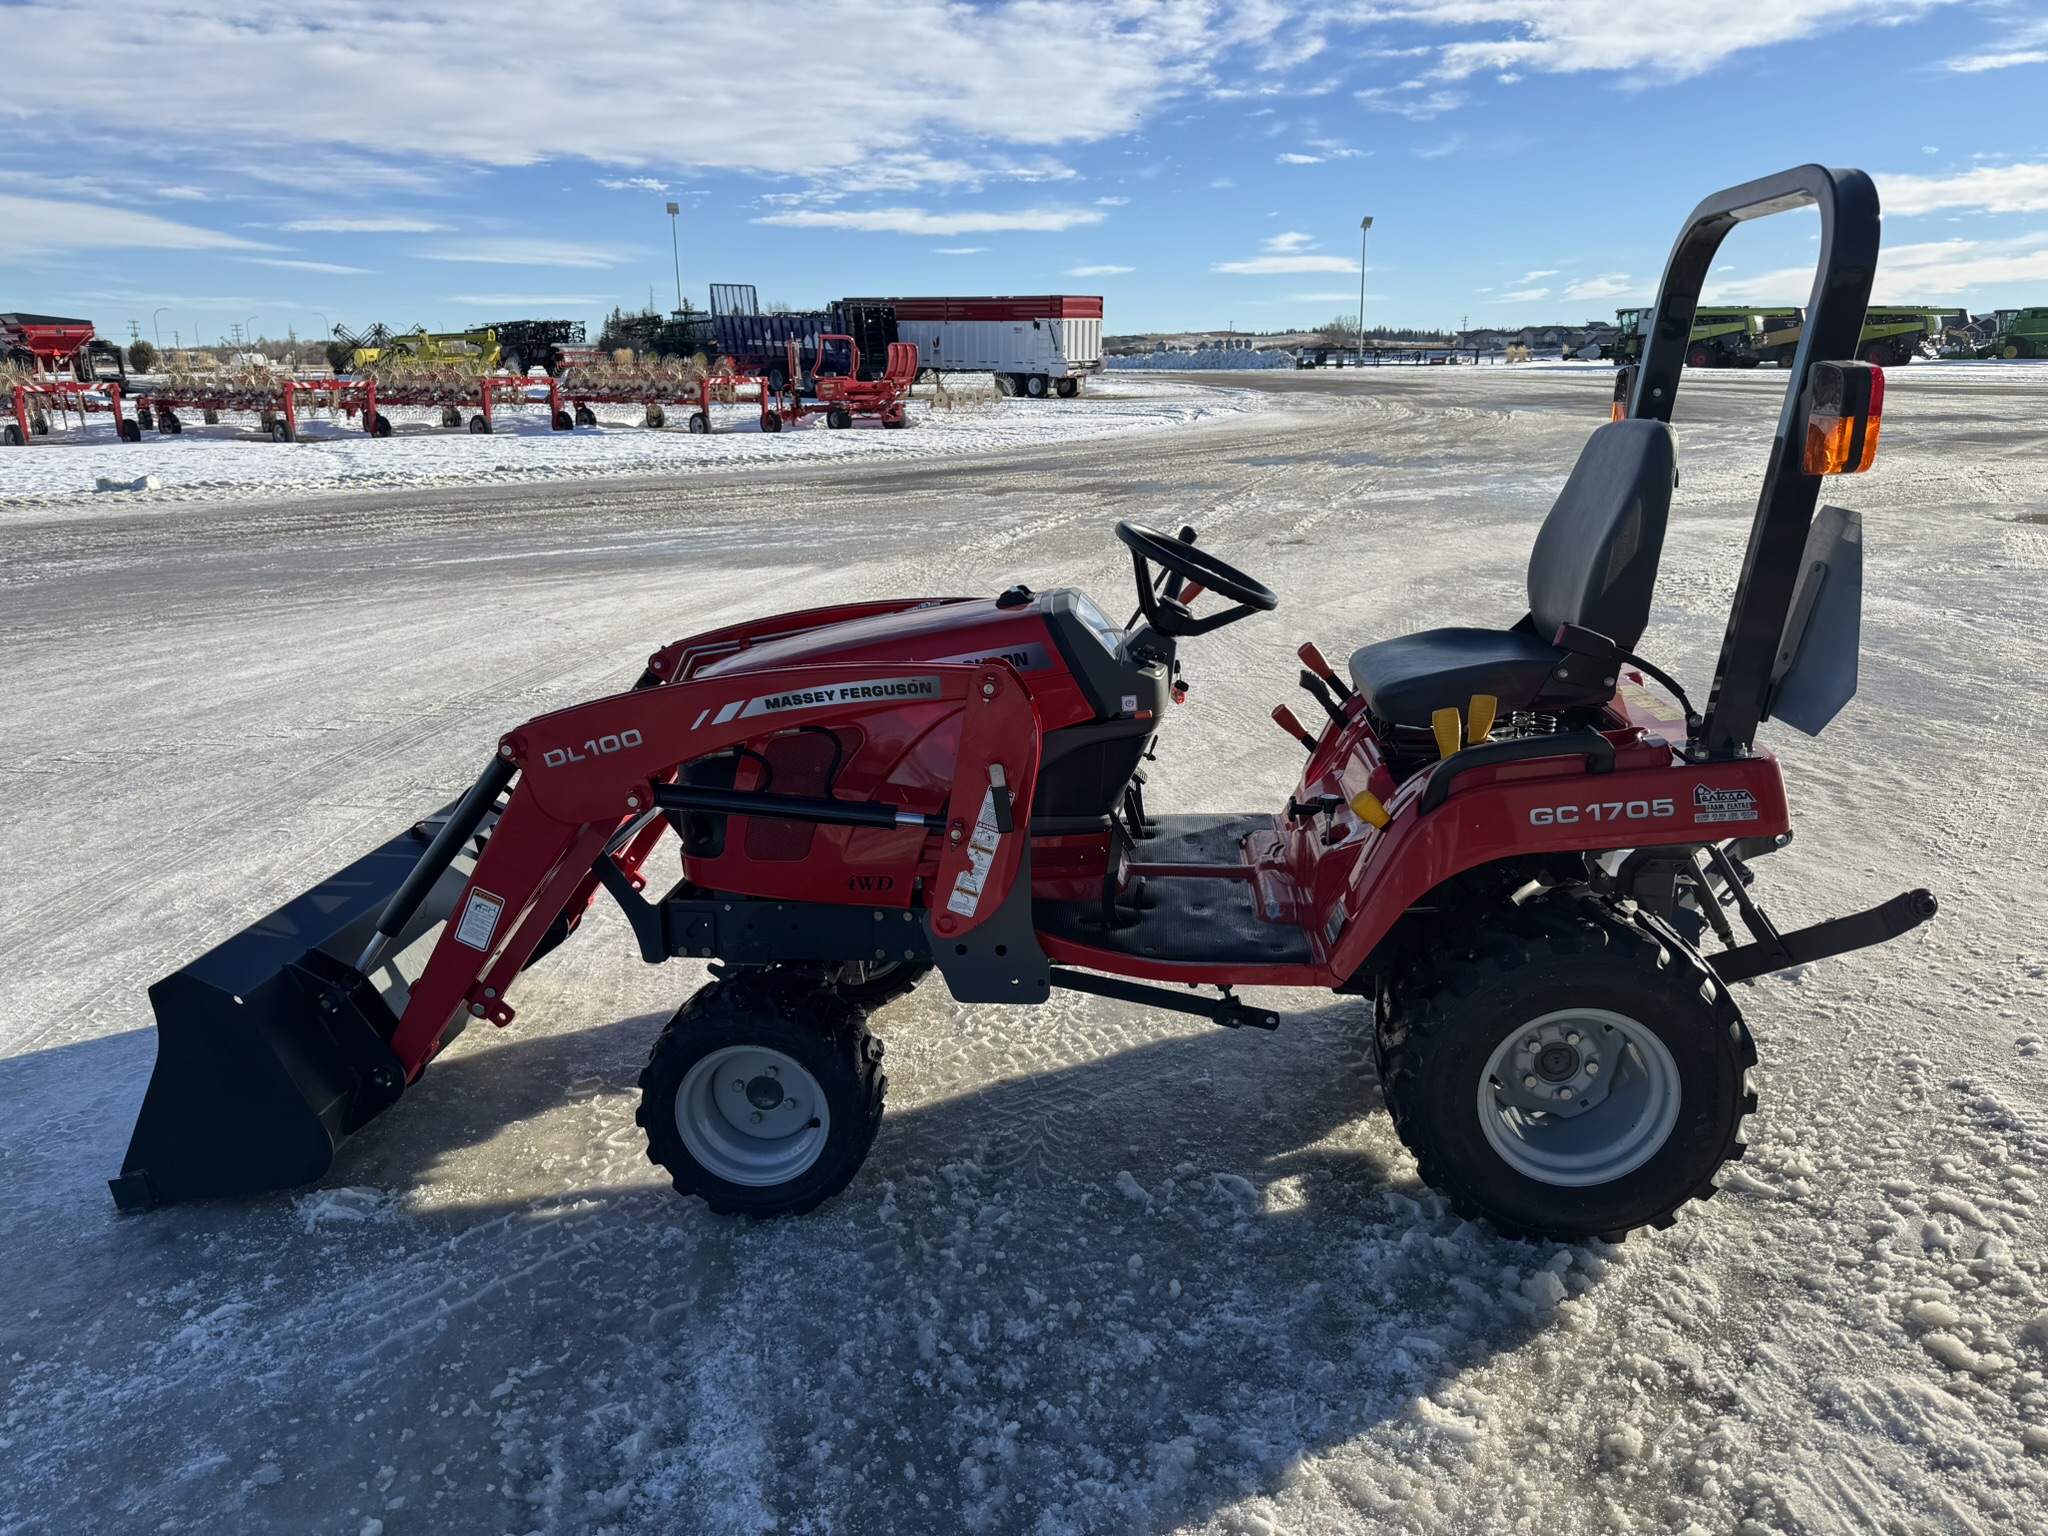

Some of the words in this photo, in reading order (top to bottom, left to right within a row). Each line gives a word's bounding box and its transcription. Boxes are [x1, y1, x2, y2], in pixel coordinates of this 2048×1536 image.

[764, 690, 835, 710] MASSEY
[840, 681, 933, 700] FERGUSON
[543, 728, 643, 768] DL100
[1694, 784, 1755, 804] Pentagon
[1529, 798, 1675, 826] GC1705
[1706, 803, 1726, 811] FARM
[842, 875, 895, 891] 4WD
